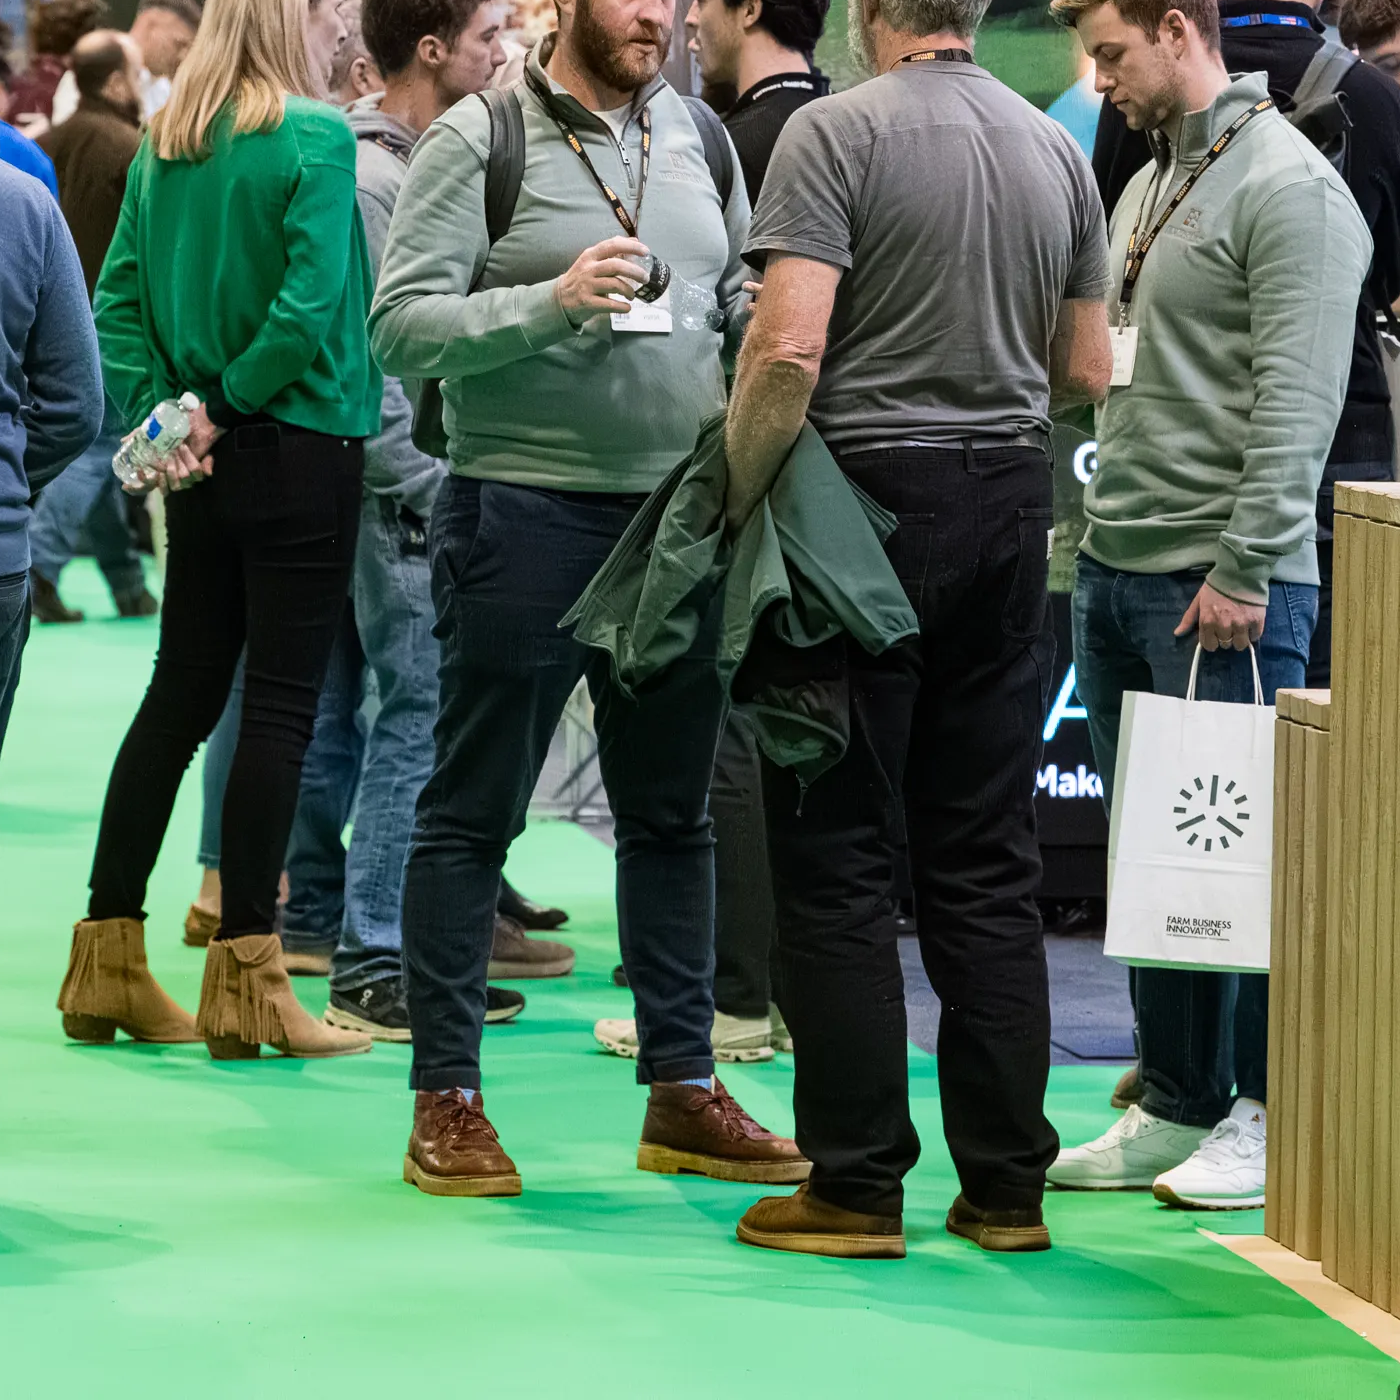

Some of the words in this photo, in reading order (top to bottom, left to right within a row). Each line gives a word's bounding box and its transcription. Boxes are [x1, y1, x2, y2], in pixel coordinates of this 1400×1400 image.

[1166, 915, 1191, 927] FARM
[1192, 917, 1232, 930] BUSINESS
[1166, 924, 1222, 937] INNOVATION
